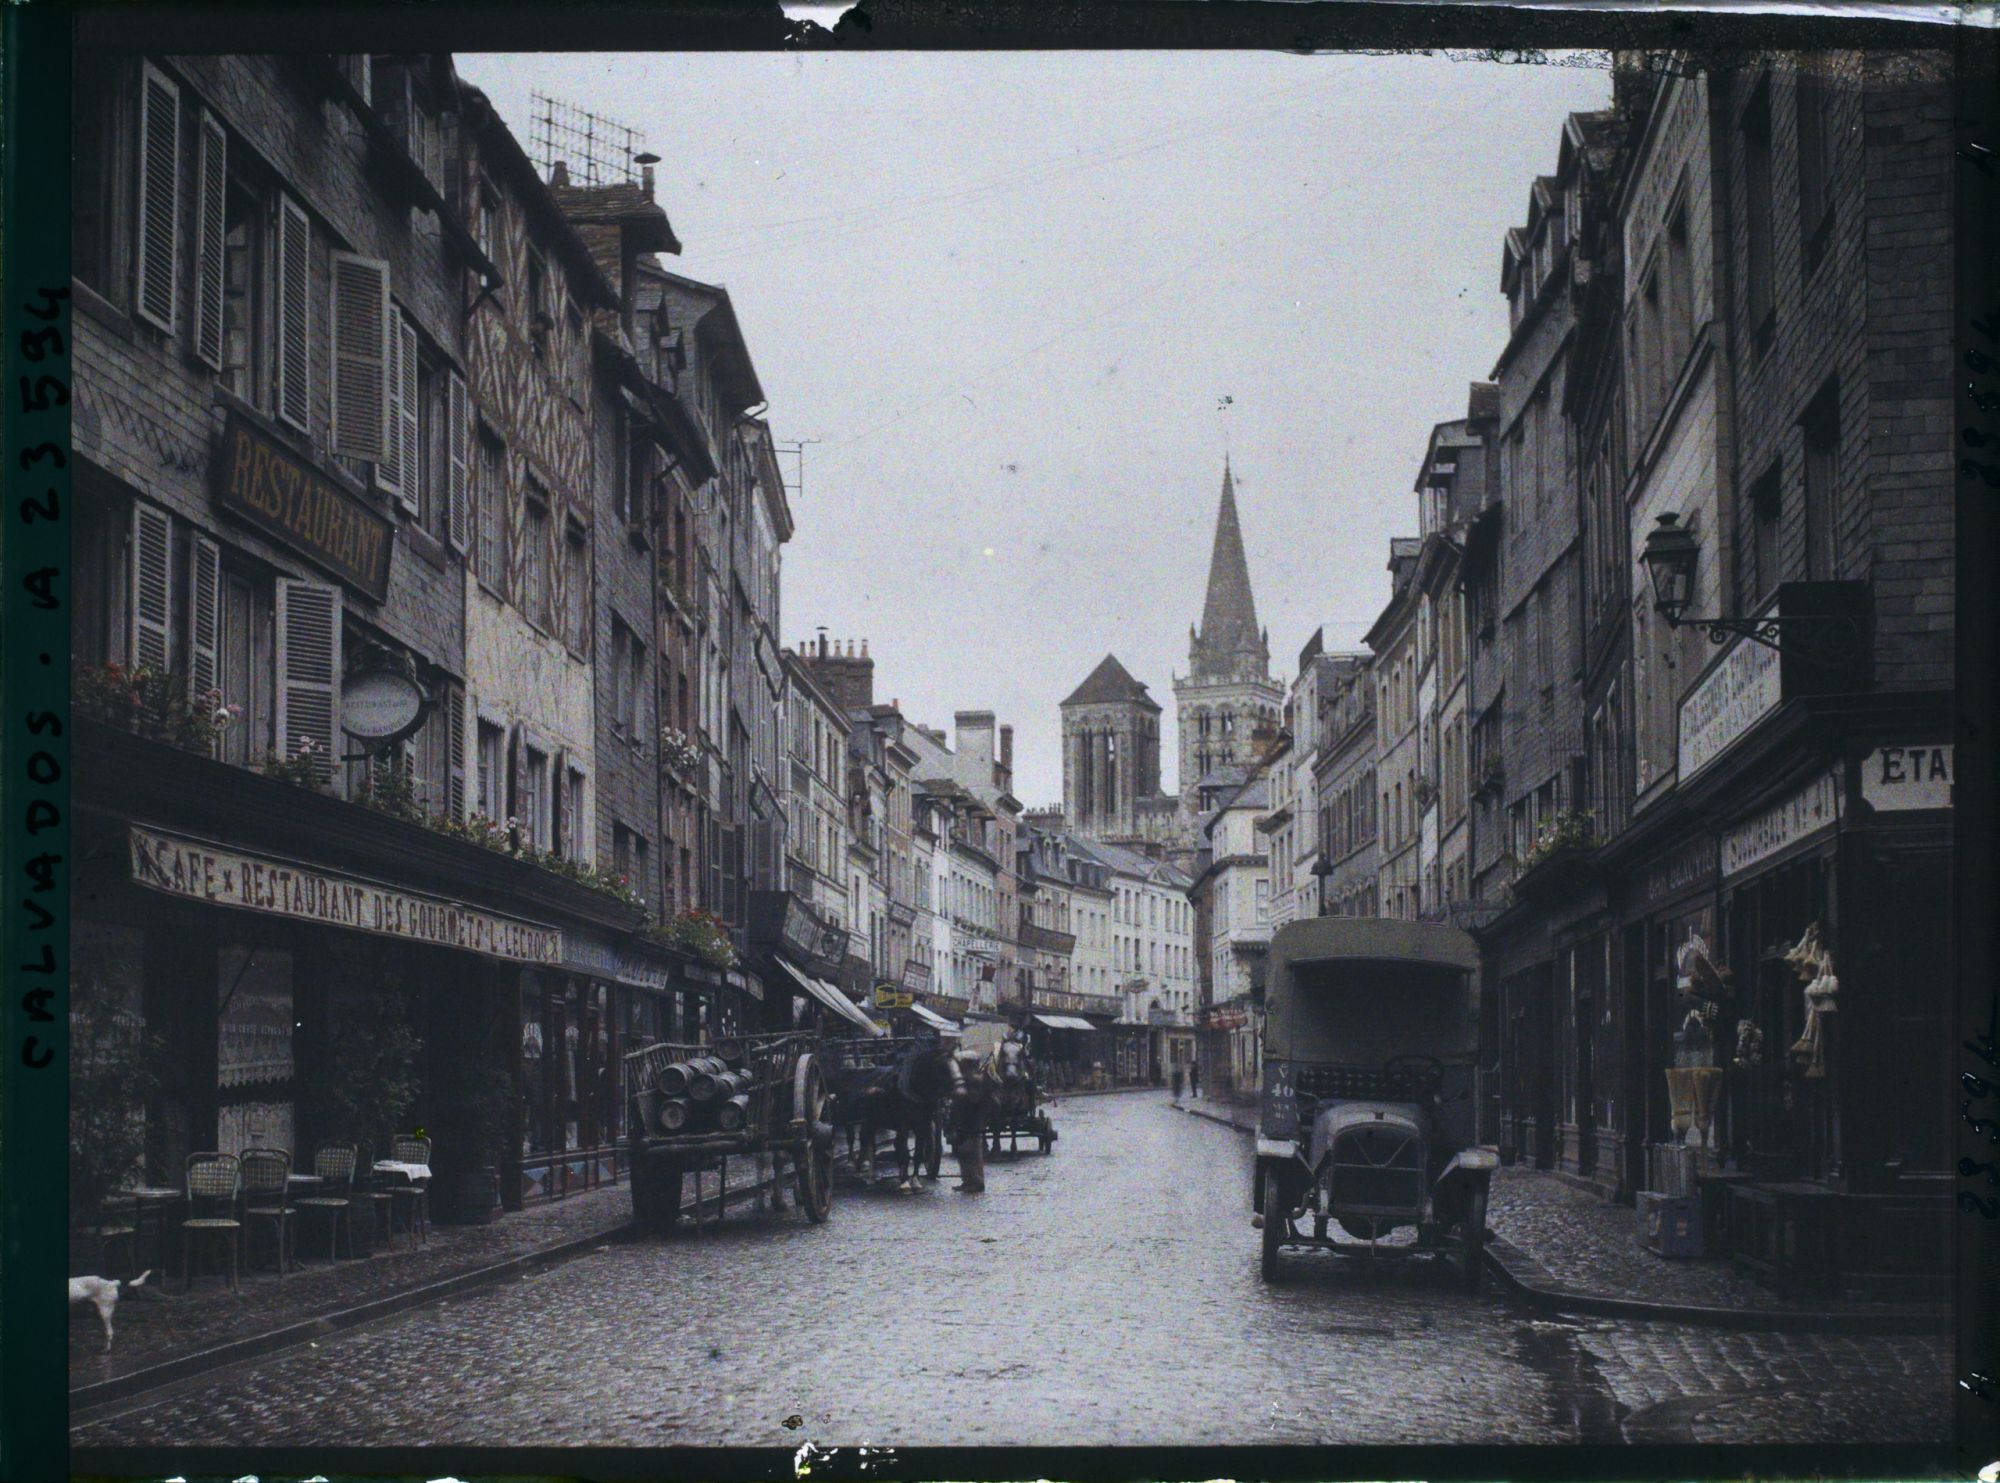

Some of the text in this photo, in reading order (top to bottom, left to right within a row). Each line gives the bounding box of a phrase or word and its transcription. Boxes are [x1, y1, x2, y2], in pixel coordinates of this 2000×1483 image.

[230, 430, 383, 582] RESTAURANT
[23, 567, 61, 610] A
[1880, 747, 1948, 785] ETA
[21, 711, 63, 1069] CALVADOS
[240, 861, 364, 926] RESTAURANT
[374, 893, 403, 933] DES
[409, 902, 483, 949] GOURMETS
